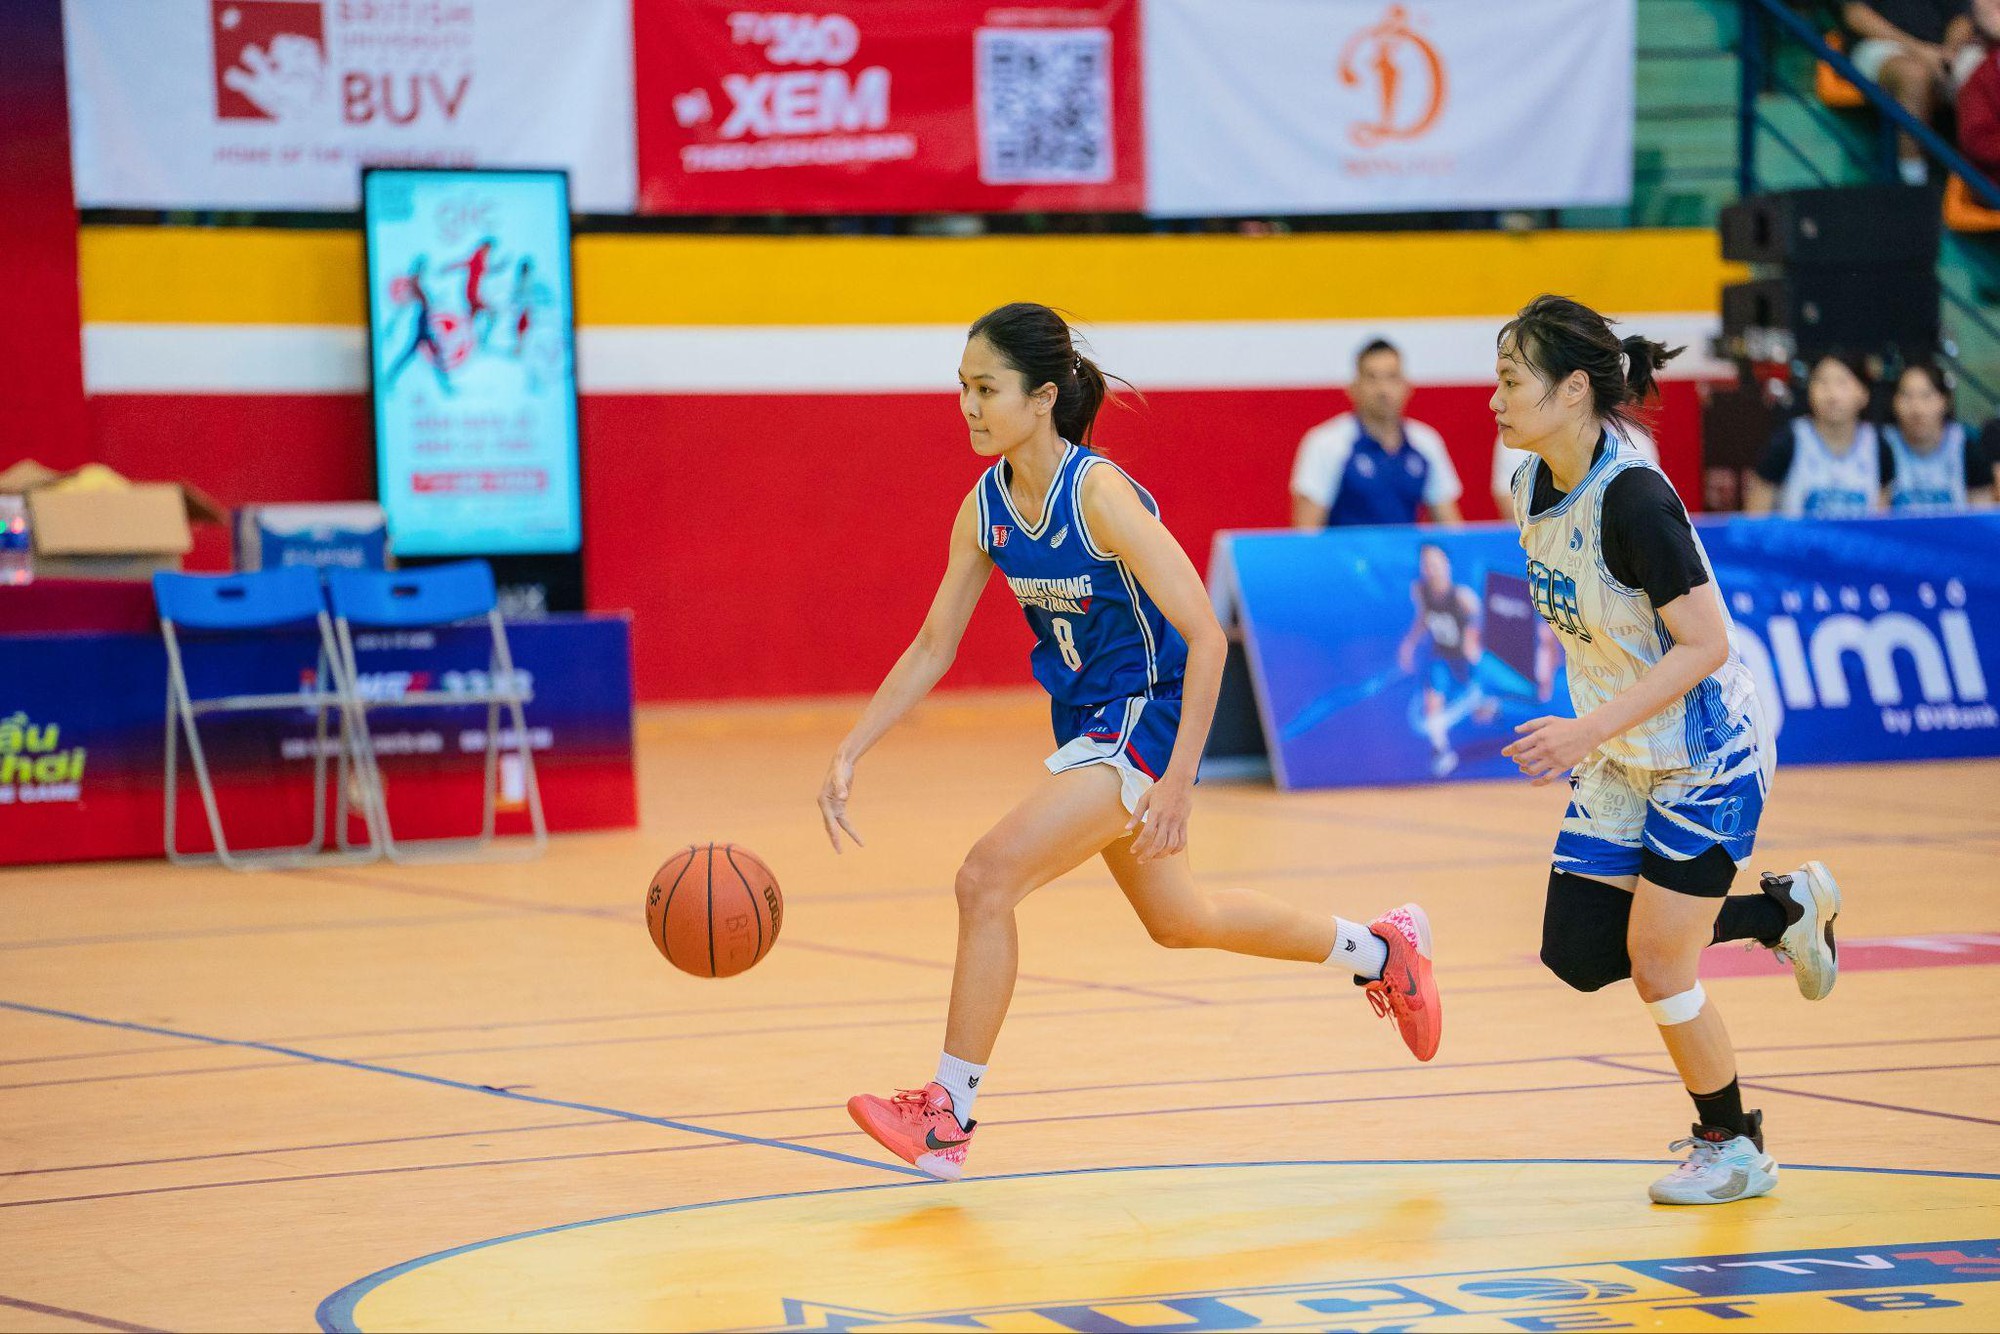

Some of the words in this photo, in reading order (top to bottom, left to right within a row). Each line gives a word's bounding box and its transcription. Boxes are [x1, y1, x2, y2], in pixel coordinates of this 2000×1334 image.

[341, 72, 472, 125] BUV
[717, 66, 892, 139] XEM
[1052, 617, 1083, 672] 8
[1712, 796, 1744, 836] 6
